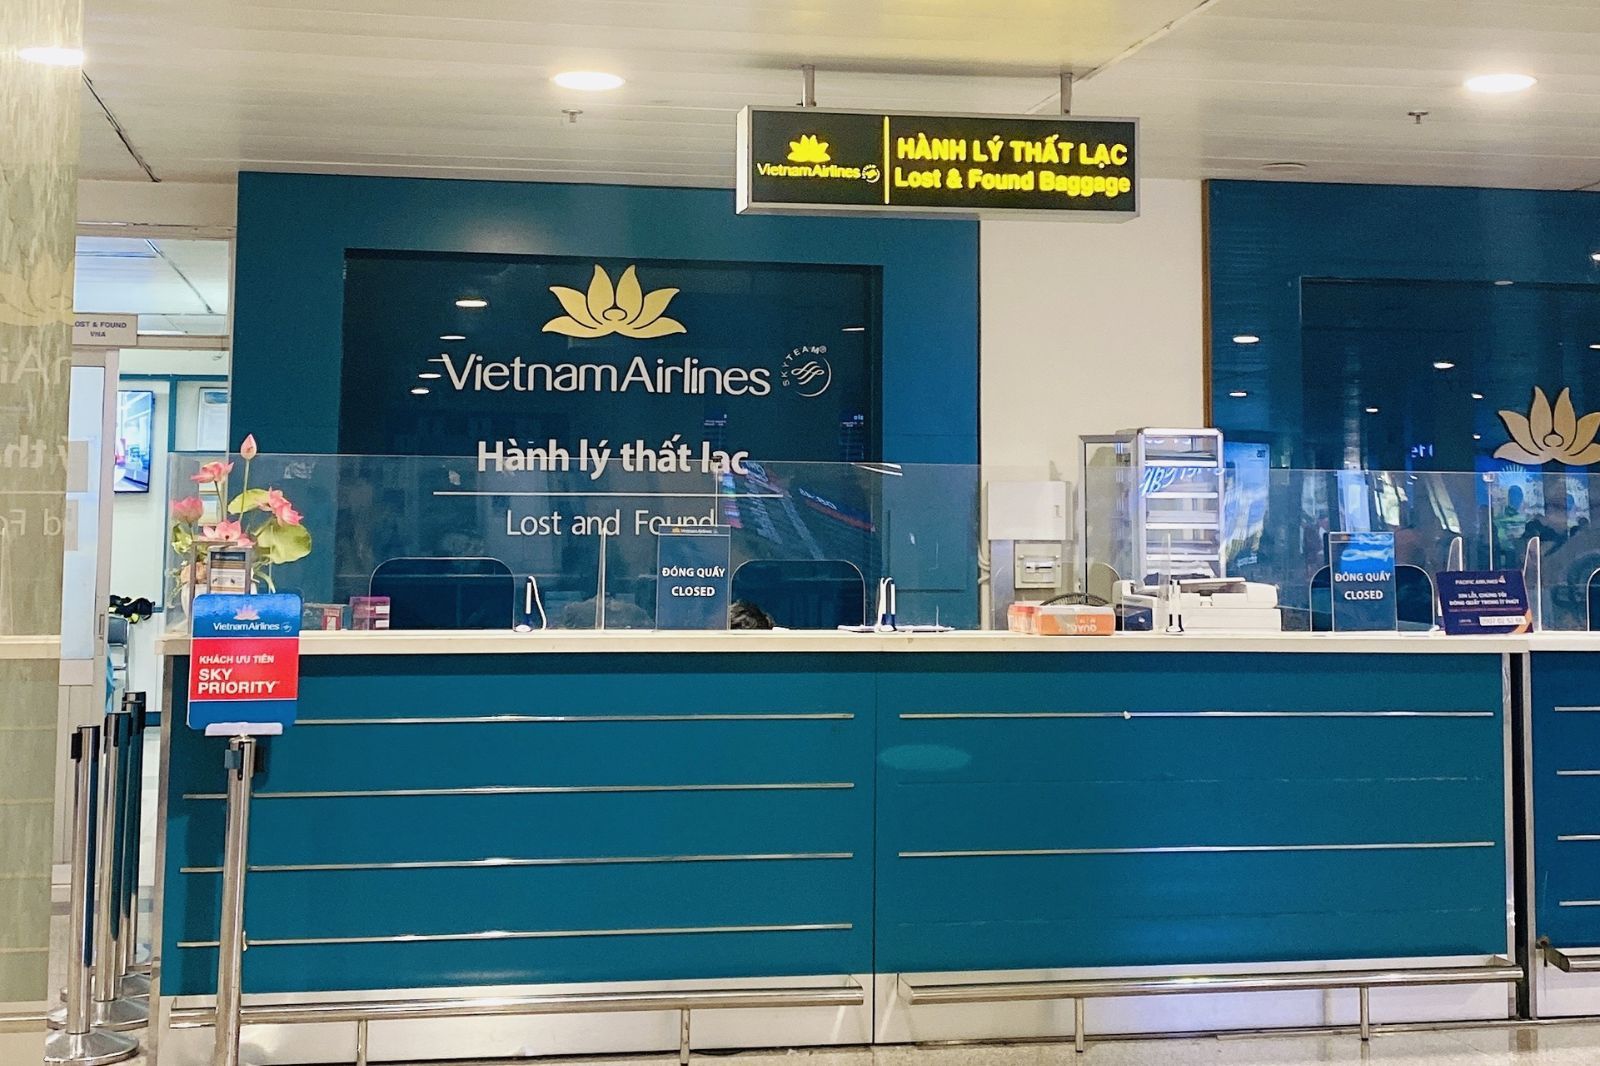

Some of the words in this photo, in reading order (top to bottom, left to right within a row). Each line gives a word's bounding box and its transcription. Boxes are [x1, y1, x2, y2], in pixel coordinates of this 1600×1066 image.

[897, 132, 967, 161] HÀNH
[972, 135, 1004, 162] LÝ
[1009, 134, 1074, 164] THẤT
[1079, 143, 1128, 168] LẠC
[894, 167, 942, 189] Lost
[946, 168, 964, 189] &
[967, 169, 1035, 191] Found
[1039, 170, 1131, 198] Baggage
[478, 438, 570, 472] Hành
[580, 438, 612, 481] lý
[620, 434, 692, 473] thất
[506, 509, 562, 536] Lost
[571, 508, 620, 536] and
[661, 565, 695, 577] ĐÓNG
[1334, 571, 1363, 582] ĐÓNG
[671, 586, 715, 597] CLOSED
[1344, 590, 1383, 600] CLOSED
[199, 654, 234, 664] KHÁCH
[236, 655, 250, 664] ƯU
[253, 653, 275, 664] TIÊN
[198, 668, 232, 681] SKY
[198, 681, 276, 695] PRIORITY
